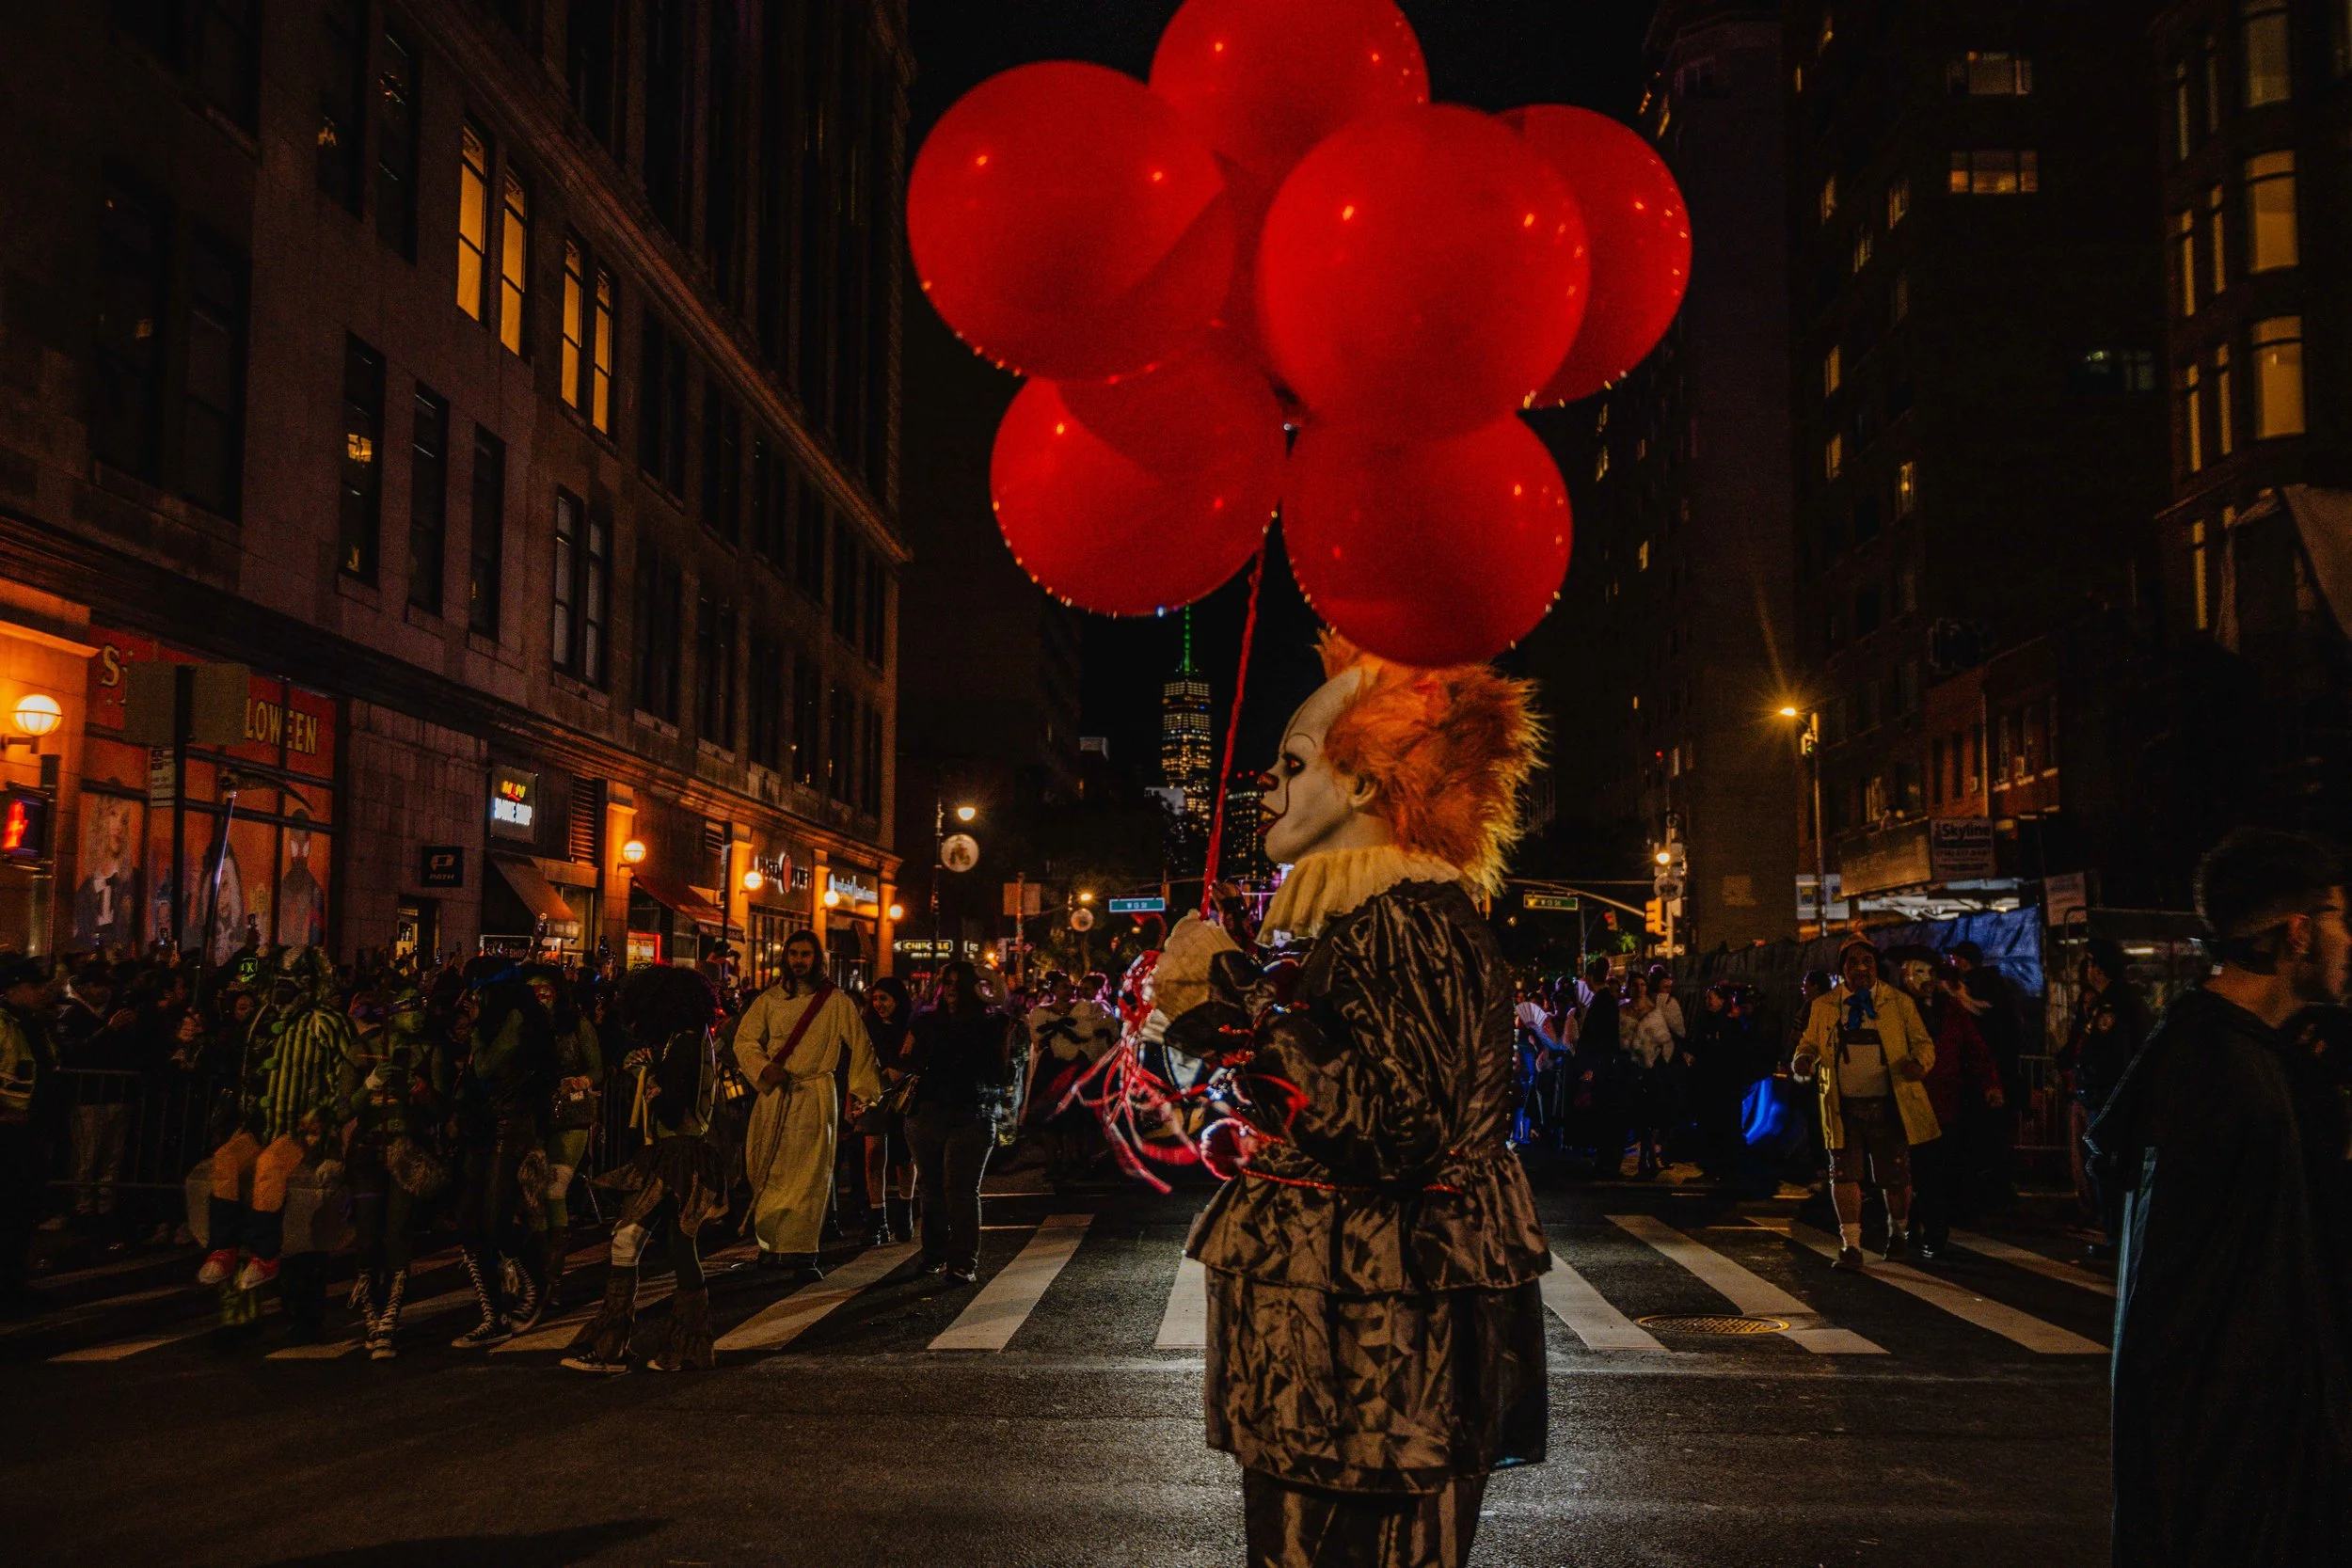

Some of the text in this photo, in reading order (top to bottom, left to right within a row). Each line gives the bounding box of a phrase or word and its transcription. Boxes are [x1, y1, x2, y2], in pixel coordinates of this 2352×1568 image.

[245, 698, 317, 755] LOWEEN
[1943, 823, 1991, 841] Skyline
[428, 873, 455, 881] PATH
[903, 942, 949, 951] CHIPOLE
